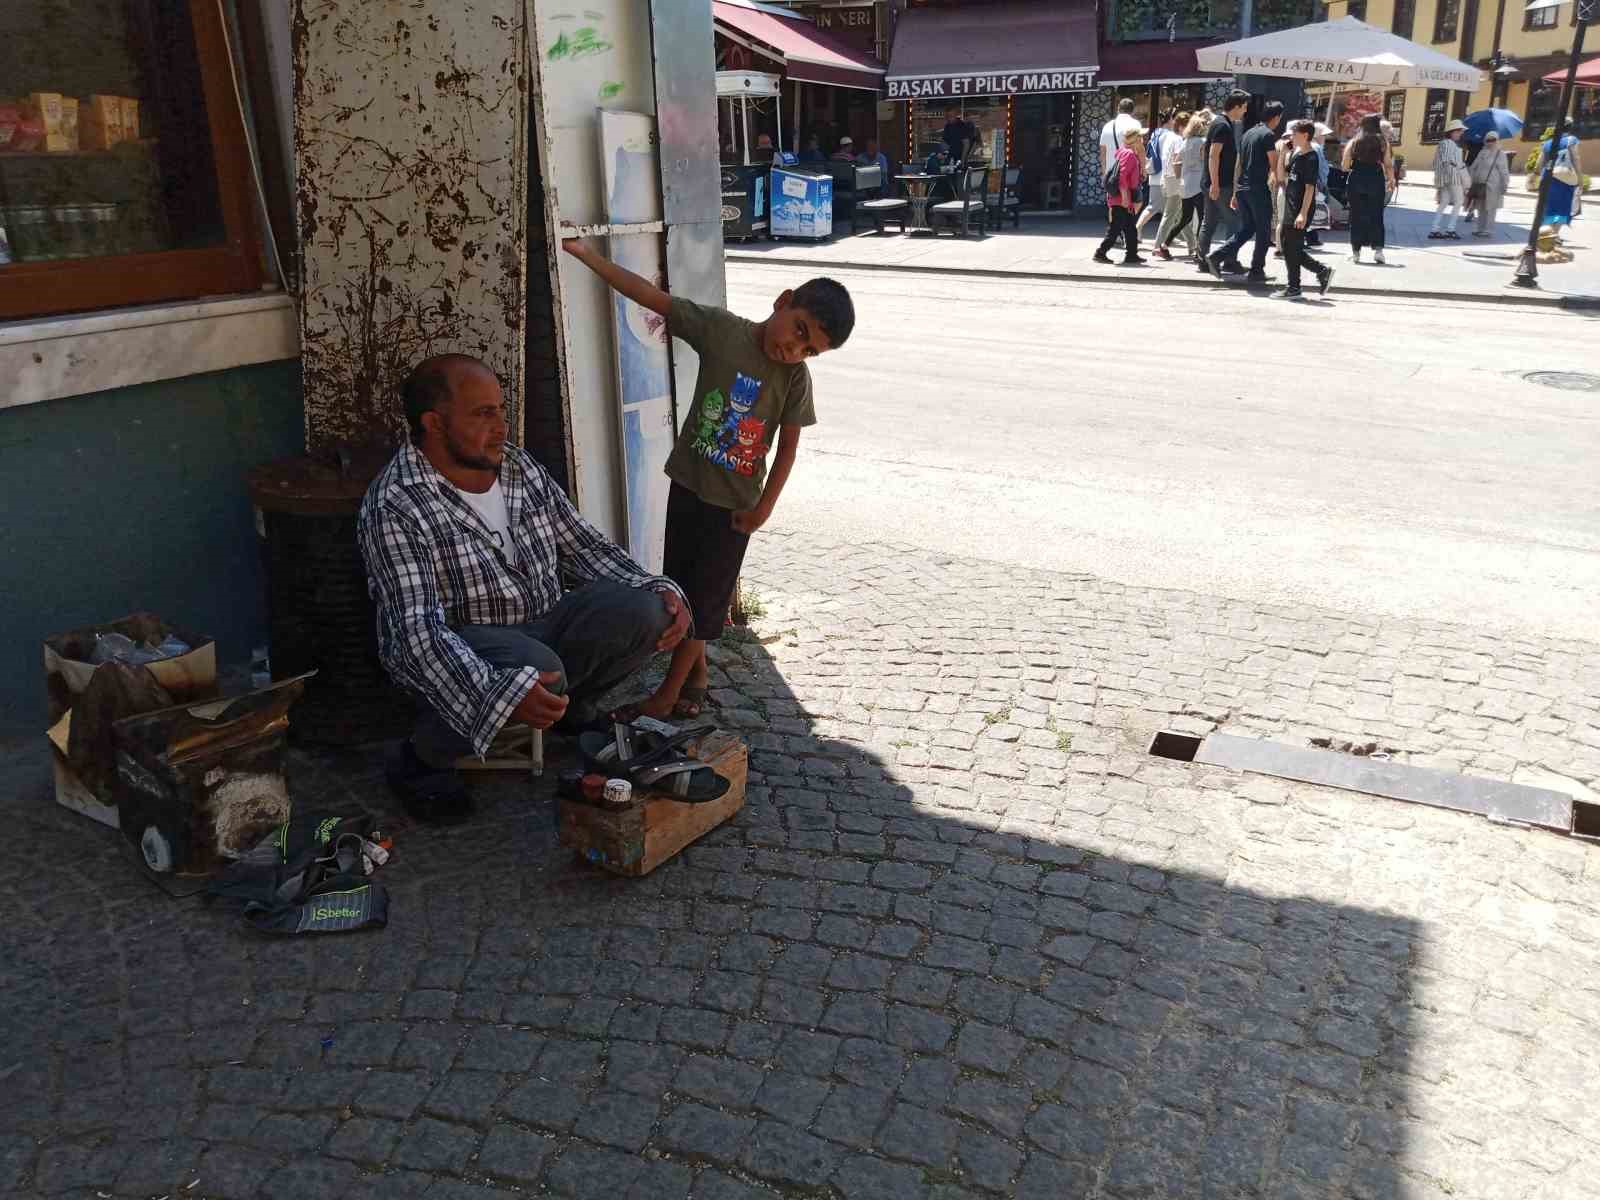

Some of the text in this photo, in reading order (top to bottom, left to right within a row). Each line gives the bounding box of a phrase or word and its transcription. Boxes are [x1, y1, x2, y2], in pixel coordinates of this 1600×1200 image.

[1234, 56, 1355, 75] LA GELATERIA
[951, 78, 973, 94] ET
[1022, 72, 1097, 91] MARKET
